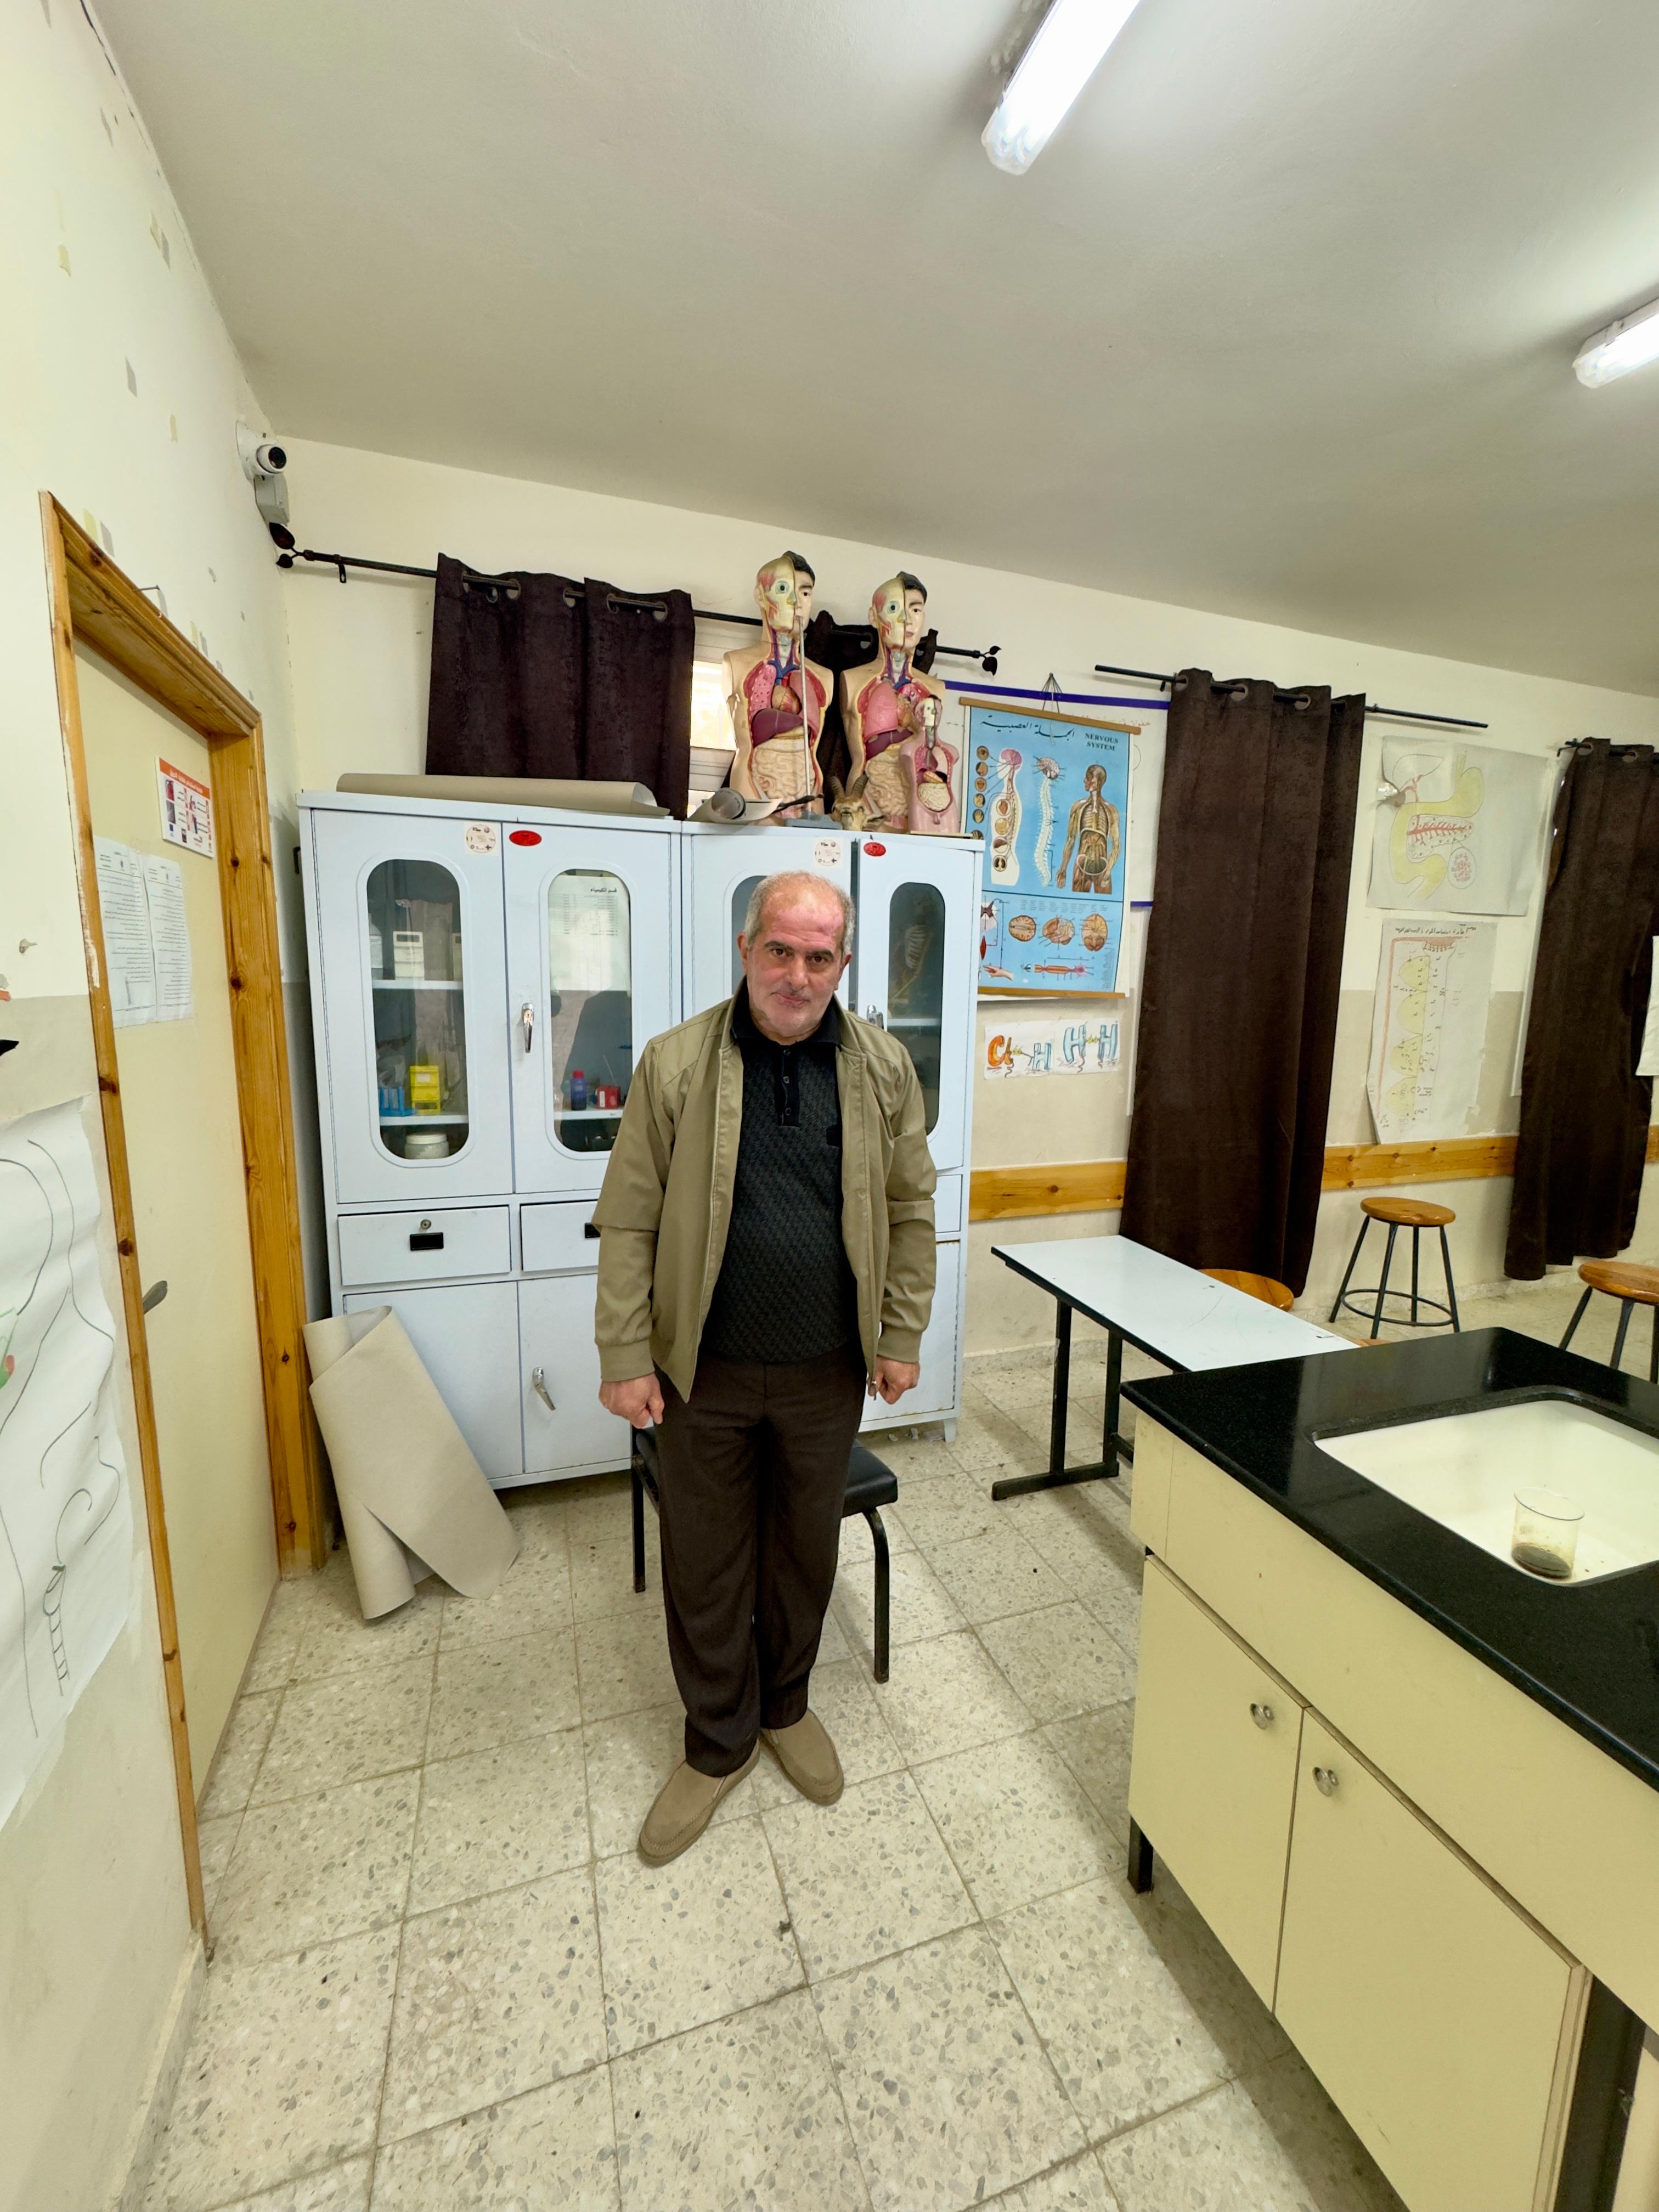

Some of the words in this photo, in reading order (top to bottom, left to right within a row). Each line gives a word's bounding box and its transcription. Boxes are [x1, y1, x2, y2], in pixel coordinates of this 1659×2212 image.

[979, 715, 1032, 733] العصبية
[1085, 733, 1119, 744] NERVOUS
[1086, 741, 1115, 751] SYSTEM
